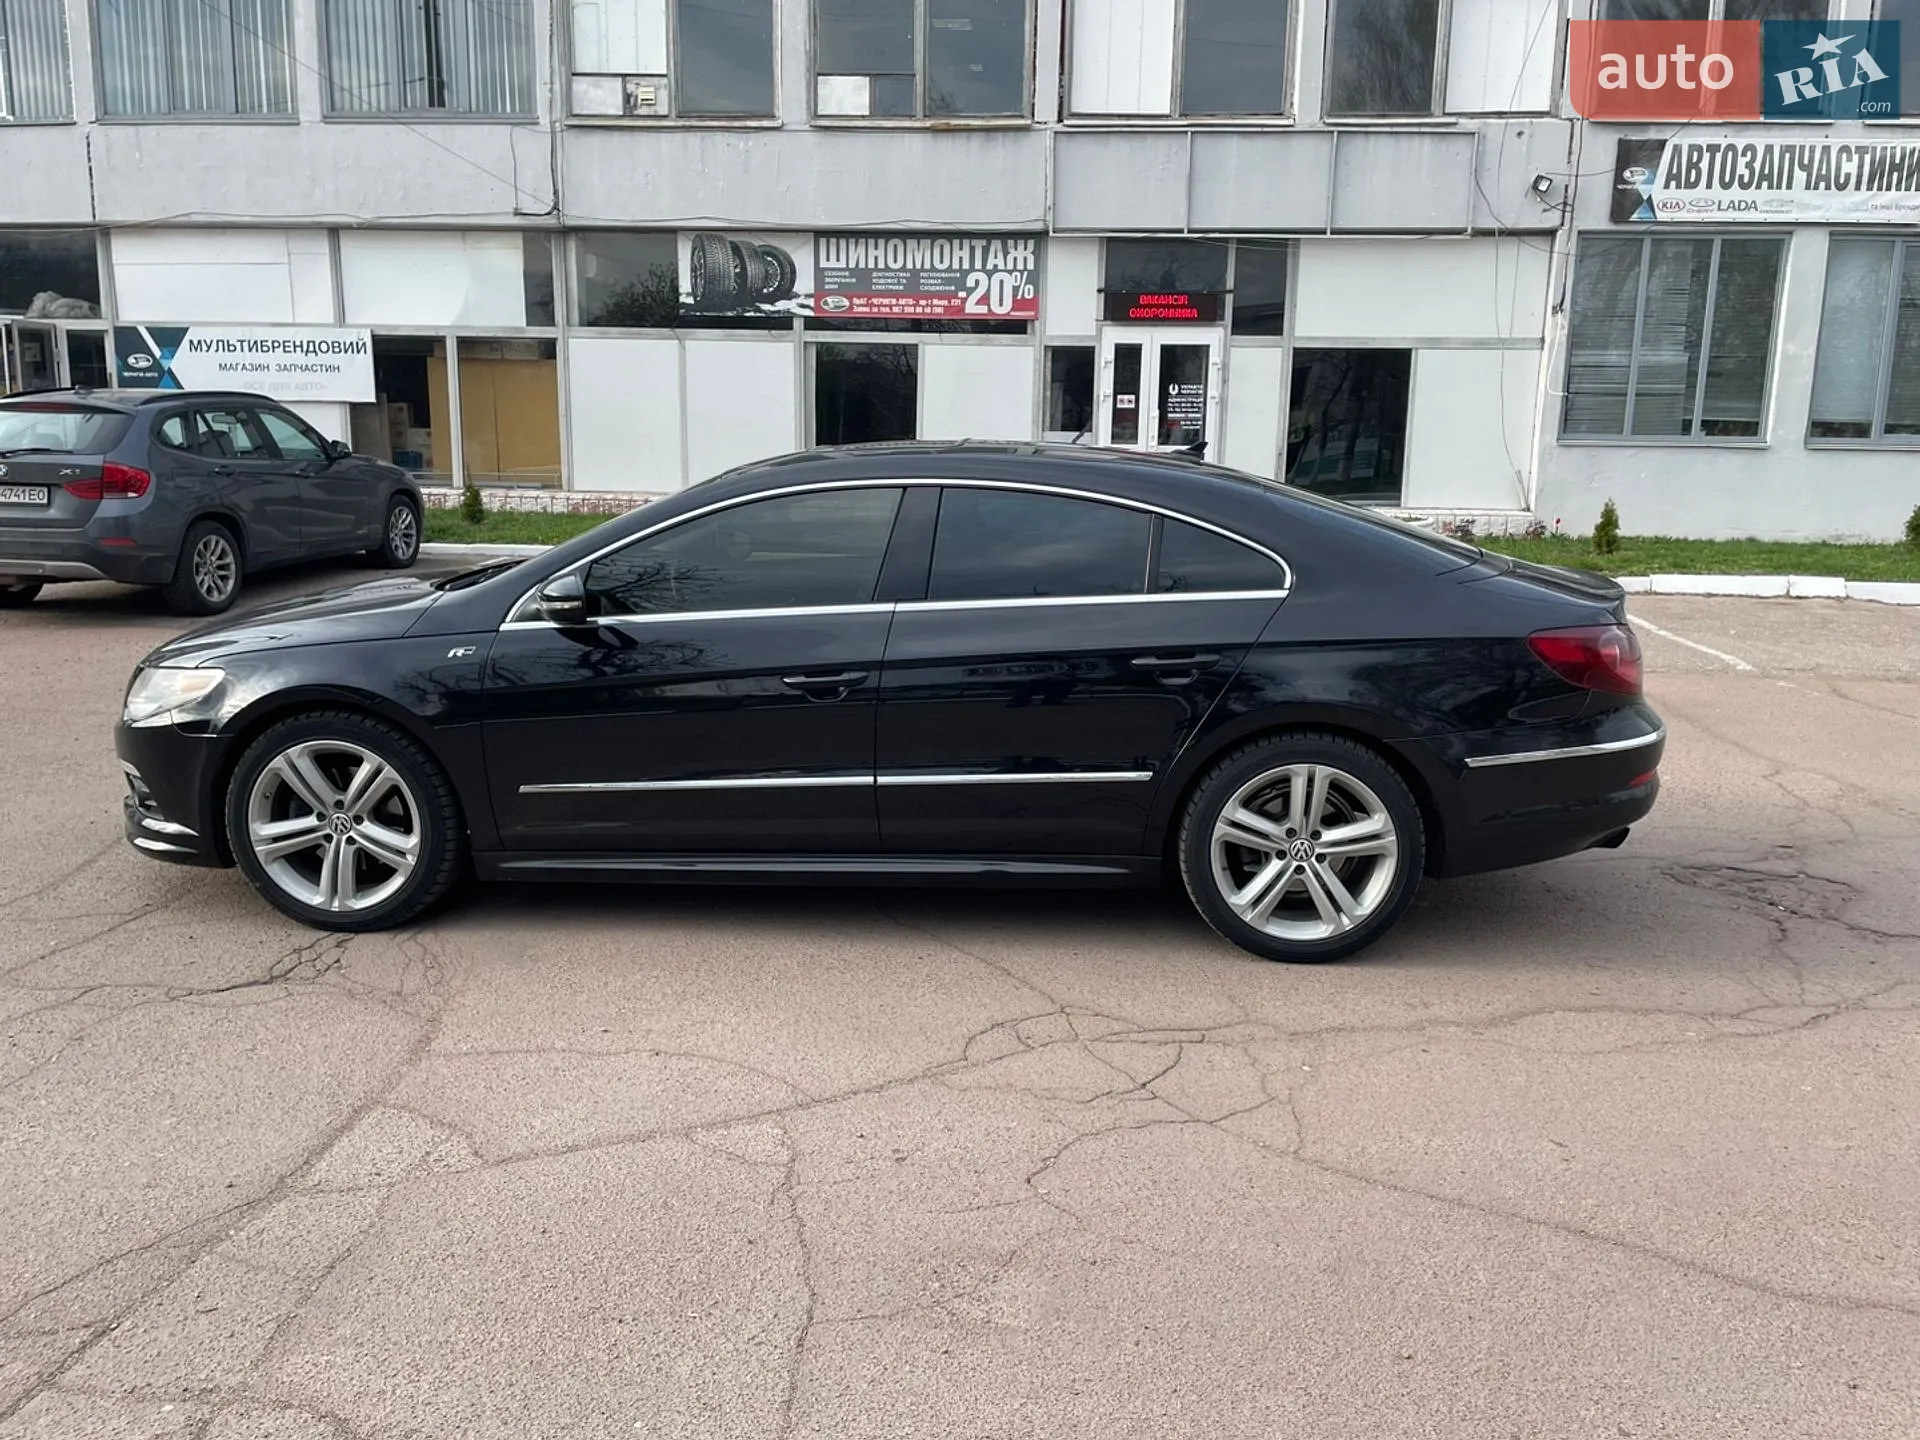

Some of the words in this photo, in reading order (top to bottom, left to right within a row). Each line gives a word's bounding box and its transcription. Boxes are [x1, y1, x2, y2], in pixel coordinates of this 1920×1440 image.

[1663, 143, 1920, 193] АВТОЗАПЧАСТИНИ
[1661, 201, 1681, 210] KIA
[1717, 200, 1759, 211] LADA
[819, 237, 1035, 270] ШИНОМОНТАЖ
[958, 271, 1034, 315] -20%
[1139, 294, 1189, 305] ВАКАНСІЯ
[1129, 307, 1198, 318] ОХОРОННИКА
[189, 337, 367, 357] МУЛЬТИБРЕНДОВИЙ
[218, 363, 270, 372] МАГАЗИН
[275, 363, 341, 373] ЗАПЧАСТИН
